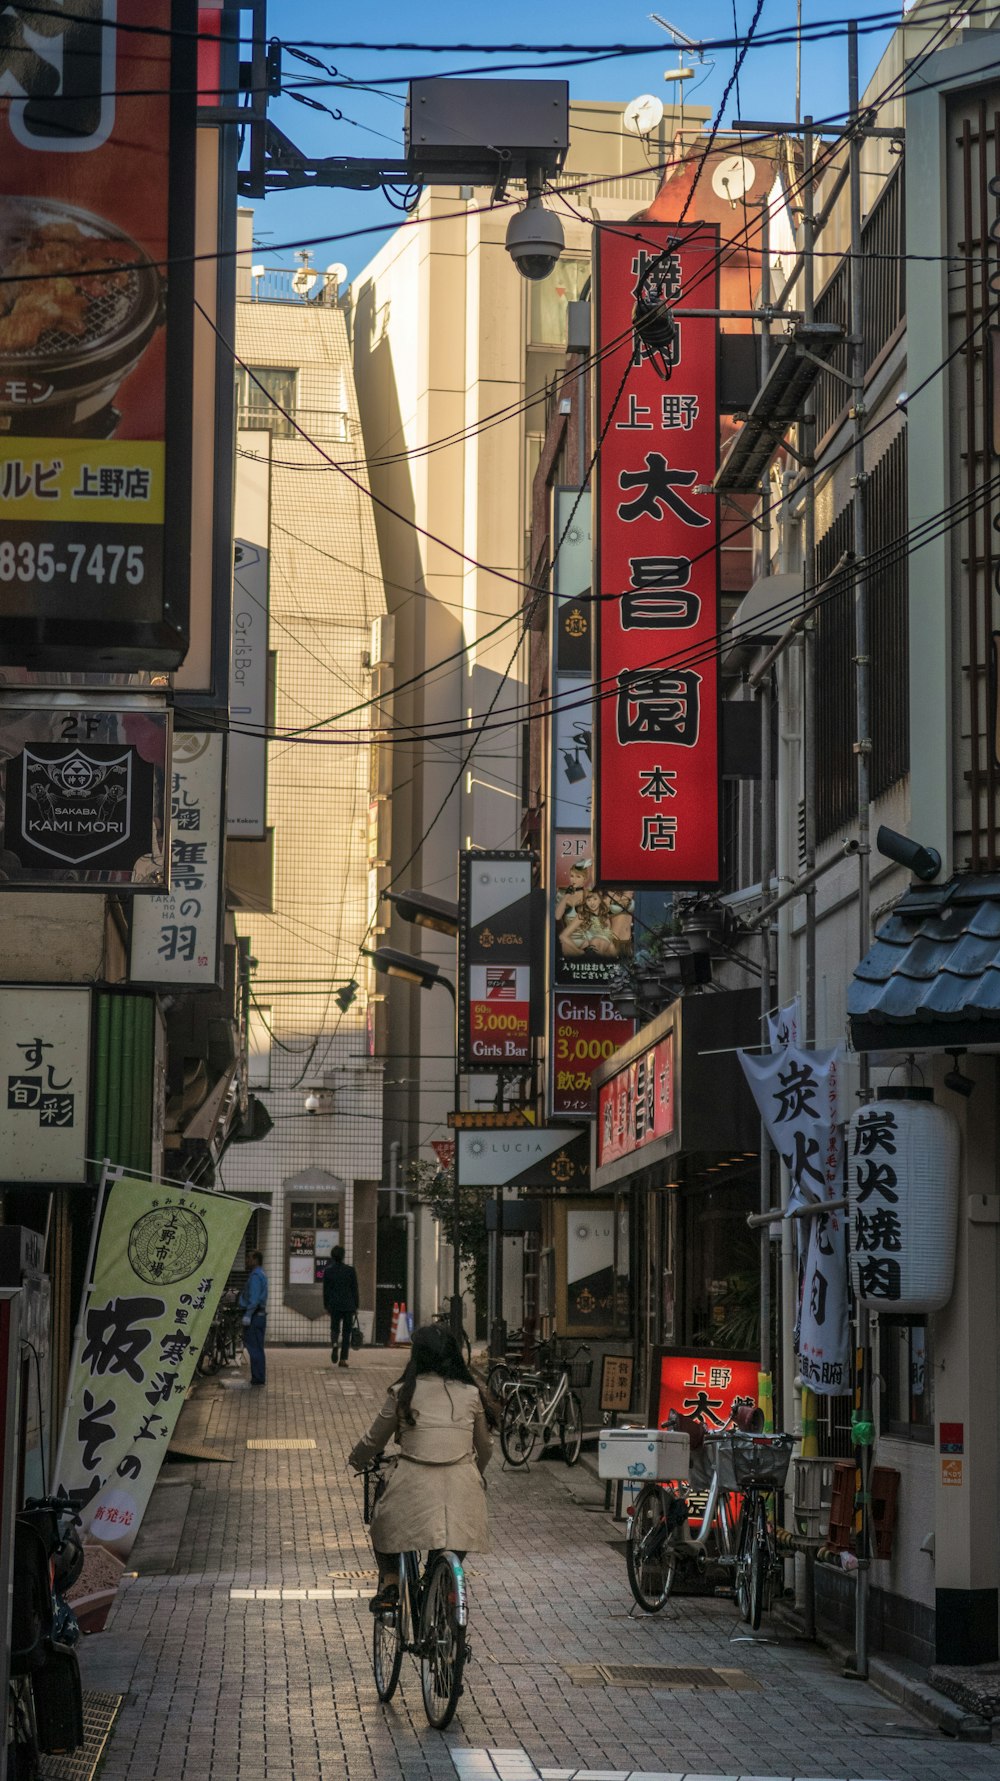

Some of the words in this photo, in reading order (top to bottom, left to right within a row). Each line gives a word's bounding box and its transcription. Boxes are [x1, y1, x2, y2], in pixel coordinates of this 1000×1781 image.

[615, 395, 699, 430] 上野
[3, 461, 62, 498] ルビ
[73, 467, 149, 498] 上野店
[0, 541, 144, 585] 835-7475
[616, 451, 711, 748] 太昌園
[61, 716, 100, 739] 2F
[639, 765, 678, 851] 本店
[29, 821, 72, 832] KAMI
[77, 821, 123, 832] MORI
[562, 840, 587, 855] 2F
[496, 937, 523, 945] VEGAS
[558, 1000, 596, 1020] Girls
[600, 1001, 628, 1020] Ba
[474, 1015, 528, 1031] 3,000円
[559, 1026, 579, 1036] 60分
[473, 1041, 501, 1055] Girls
[505, 1041, 528, 1056] Bar
[563, 1101, 587, 1109] ワイン
[492, 1143, 542, 1153] LUCIA
[853, 1110, 902, 1300] 炭火焼肉
[149, 1214, 178, 1277] 上野市場
[618, 1362, 628, 1402] 営業中
[684, 1365, 732, 1389] 上野
